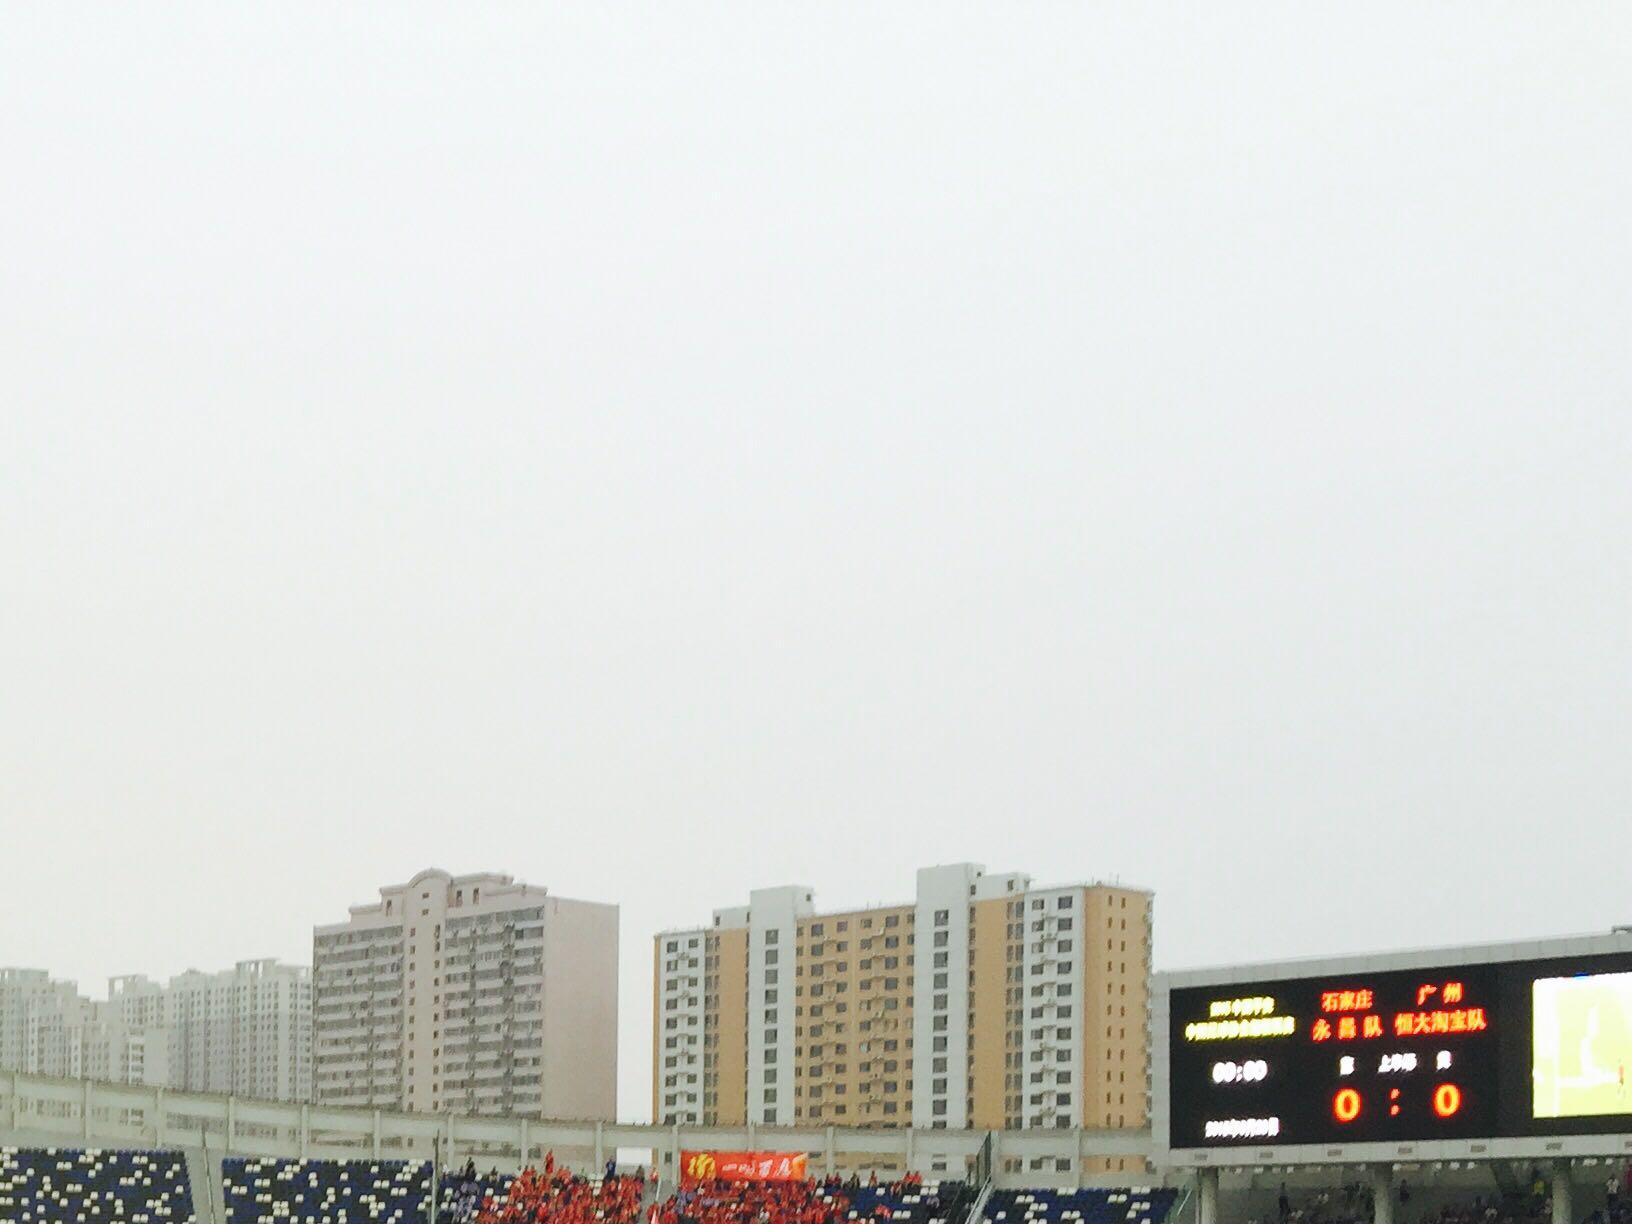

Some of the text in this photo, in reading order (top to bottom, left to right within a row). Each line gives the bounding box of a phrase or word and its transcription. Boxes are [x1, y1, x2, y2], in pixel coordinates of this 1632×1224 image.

[1322, 989, 1373, 1012] 石家庄
[1417, 982, 1463, 1005] 广州
[1312, 1015, 1384, 1041] 永昌队
[1394, 1008, 1487, 1036] 恒大淘宝队
[1212, 1060, 1268, 1083] 00:00
[1334, 1087, 1361, 1122] 0
[1433, 1083, 1460, 1117] 0
